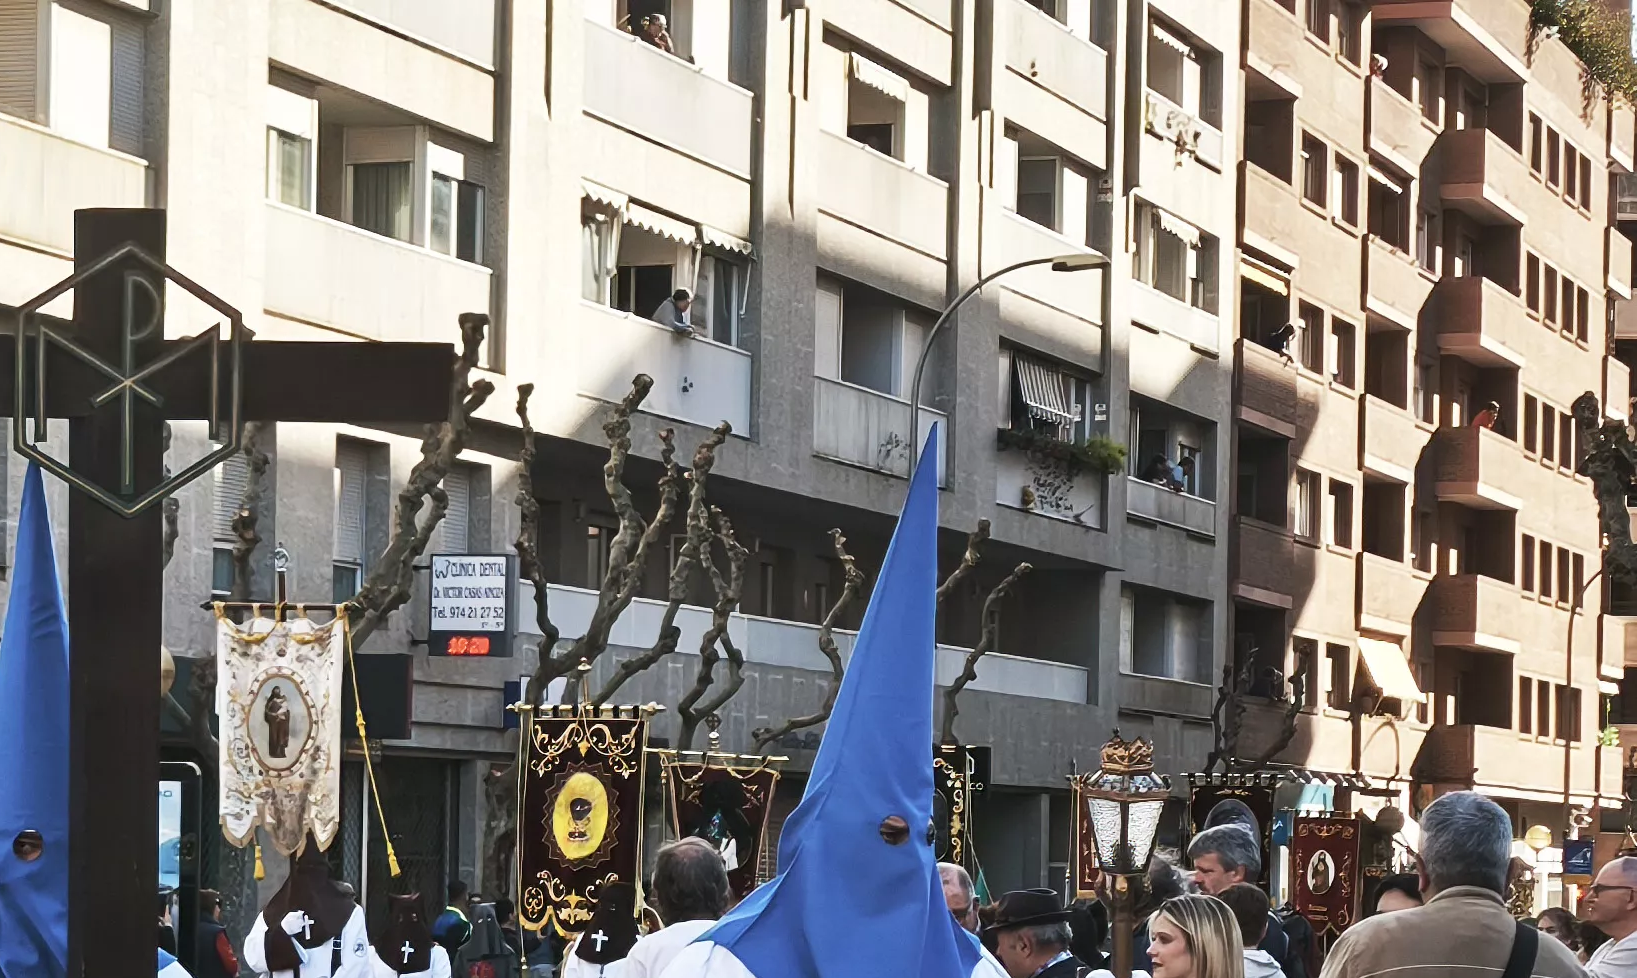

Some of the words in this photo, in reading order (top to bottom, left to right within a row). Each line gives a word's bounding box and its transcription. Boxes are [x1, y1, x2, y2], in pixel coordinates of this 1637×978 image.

[480, 563, 505, 576] DENTAL
[432, 607, 447, 618] Tel.
[449, 607, 466, 618] 974
[468, 607, 477, 618] 21
[480, 607, 492, 618] 27
[493, 607, 504, 618] 52
